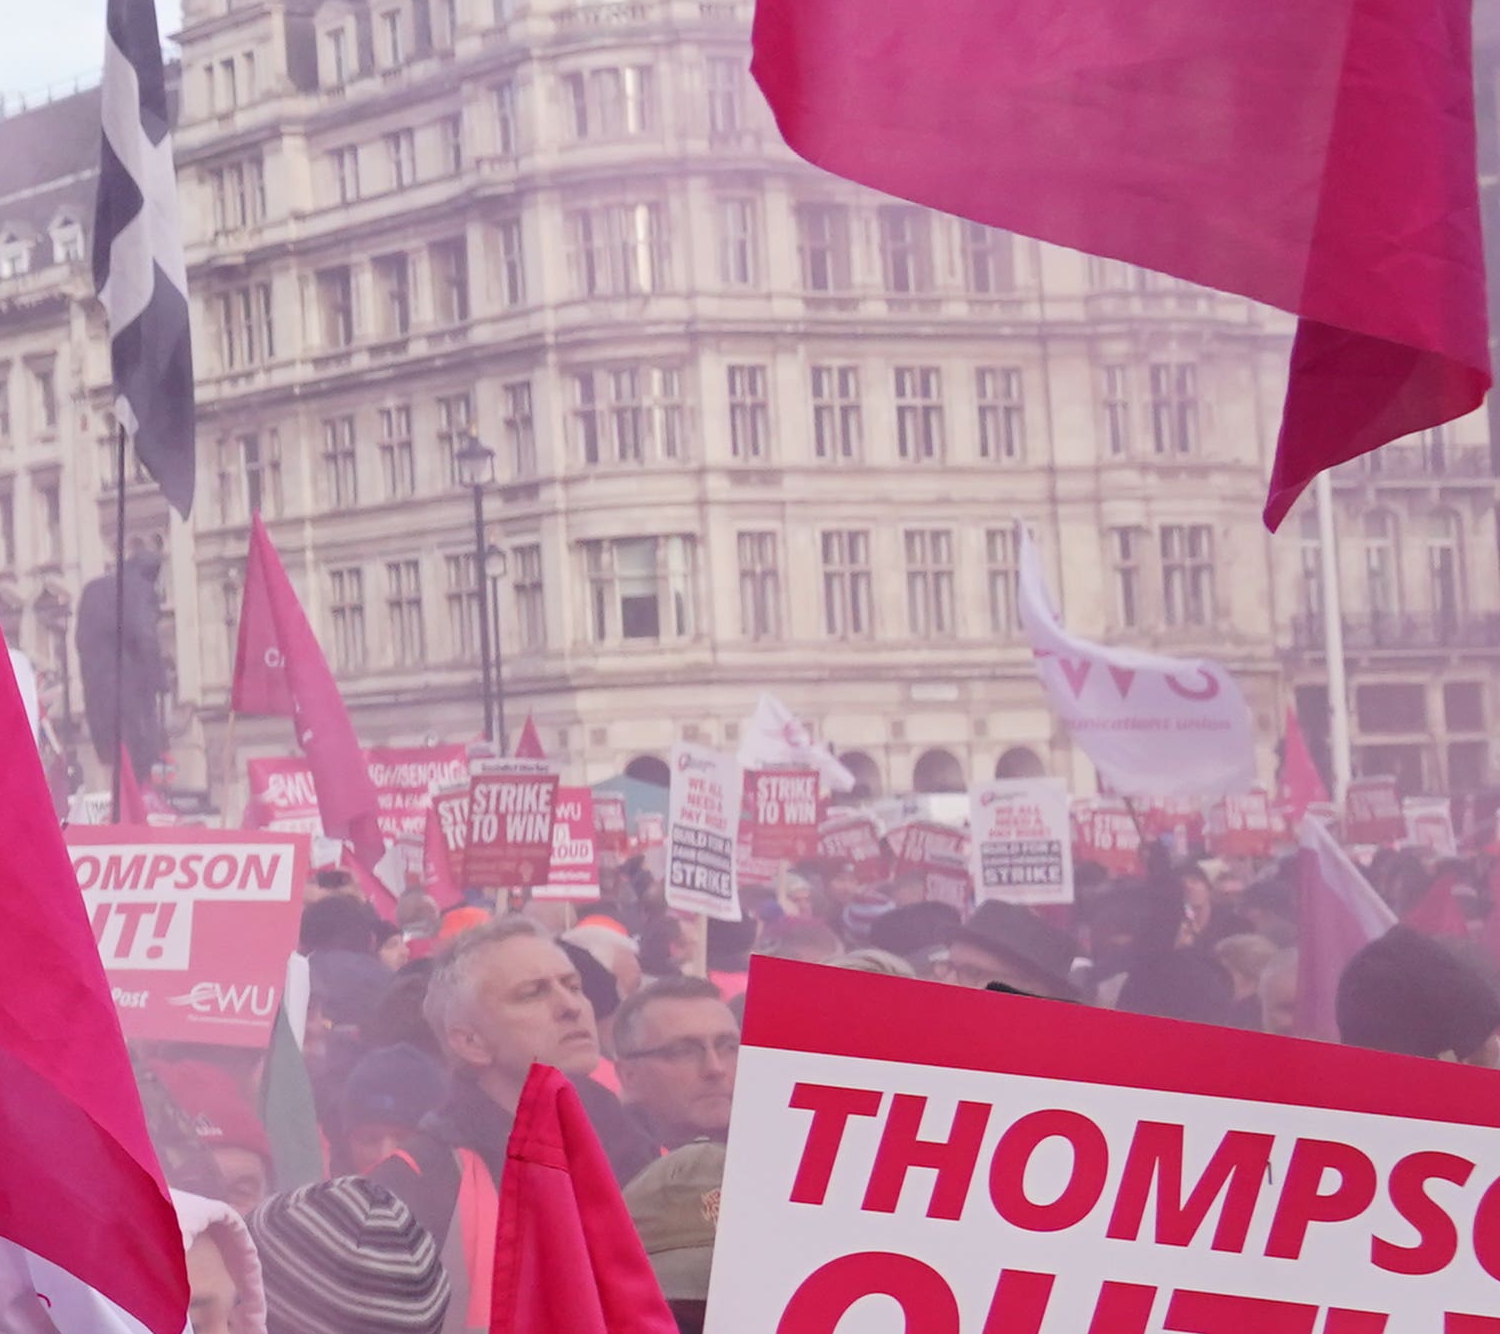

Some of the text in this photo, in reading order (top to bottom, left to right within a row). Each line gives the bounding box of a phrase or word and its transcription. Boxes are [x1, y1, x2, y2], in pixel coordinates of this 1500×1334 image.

[472, 781, 555, 816] STRIKE
[756, 775, 817, 800] STRIKE
[471, 813, 498, 844] TO
[505, 813, 553, 845] WIN
[757, 801, 817, 825] TO WIN
[70, 852, 282, 892] OMPSON
[671, 862, 732, 897] STRIKE
[165, 981, 275, 1017] CWU
[788, 1081, 1500, 1282] THOMPS
